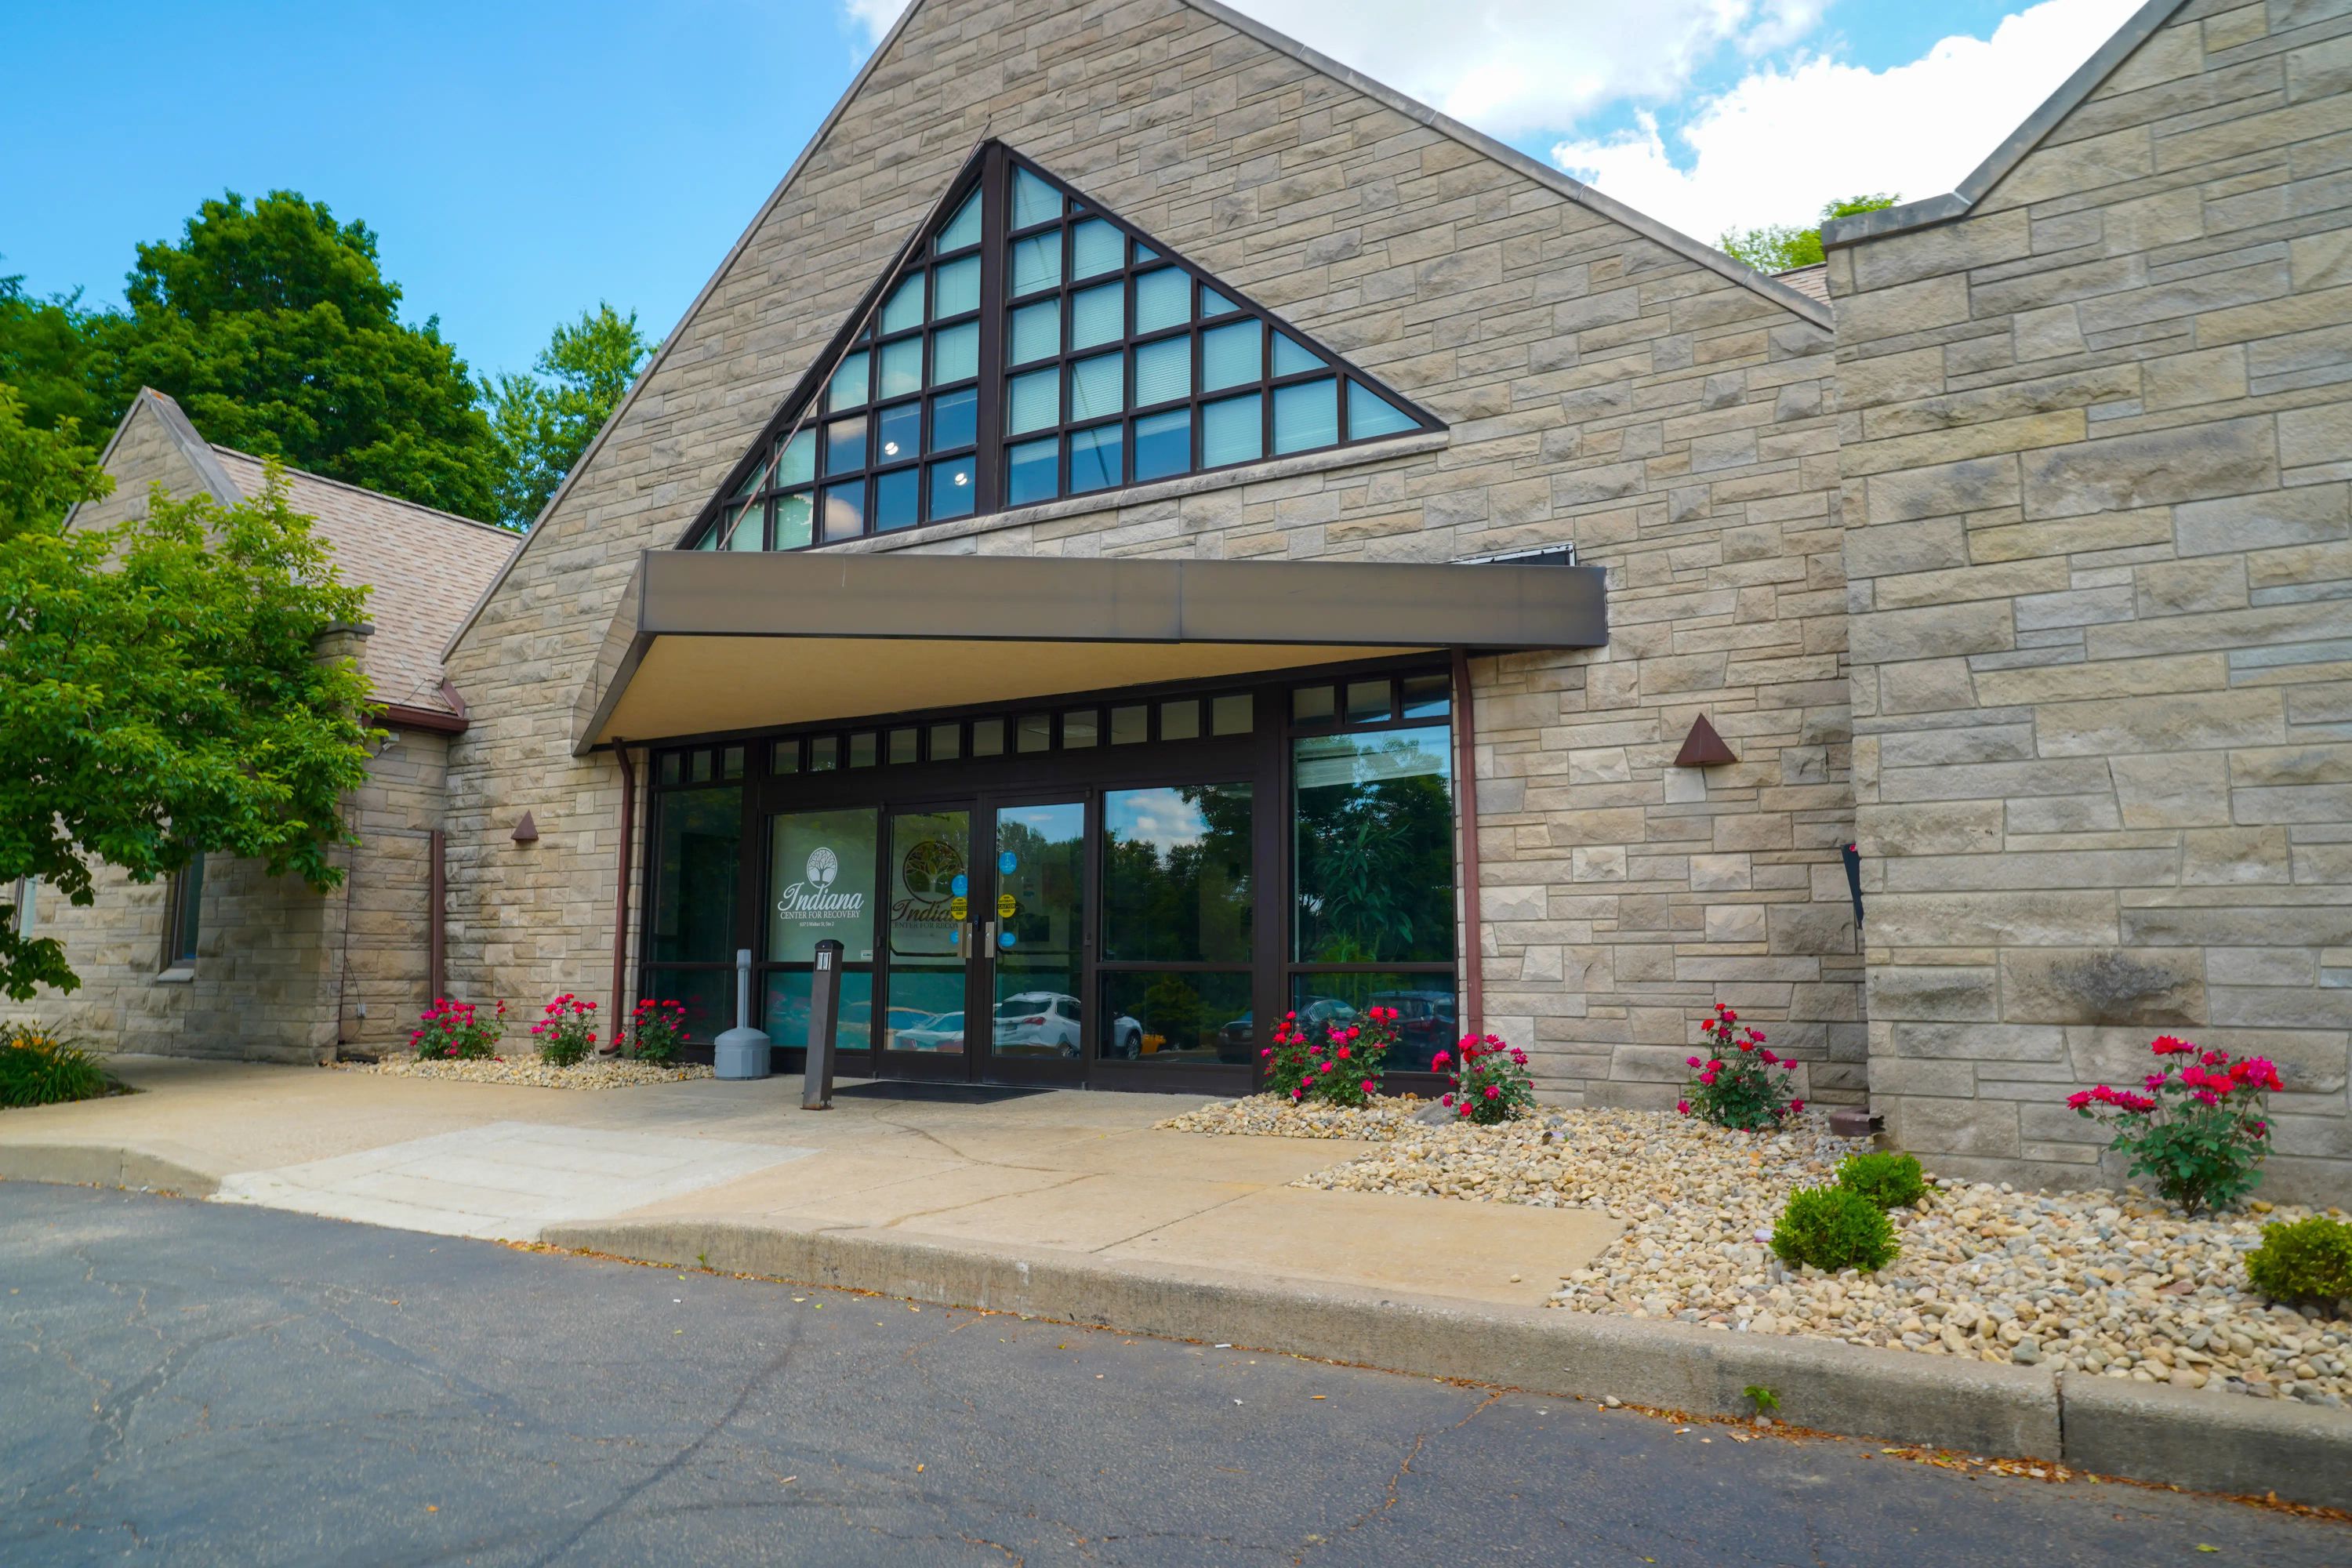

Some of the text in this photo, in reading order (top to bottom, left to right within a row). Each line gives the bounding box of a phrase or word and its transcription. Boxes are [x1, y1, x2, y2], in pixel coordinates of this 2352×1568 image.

[778, 882, 865, 911] Indiana
[823, 910, 861, 919] RECOVERY
[891, 898, 953, 921] India
